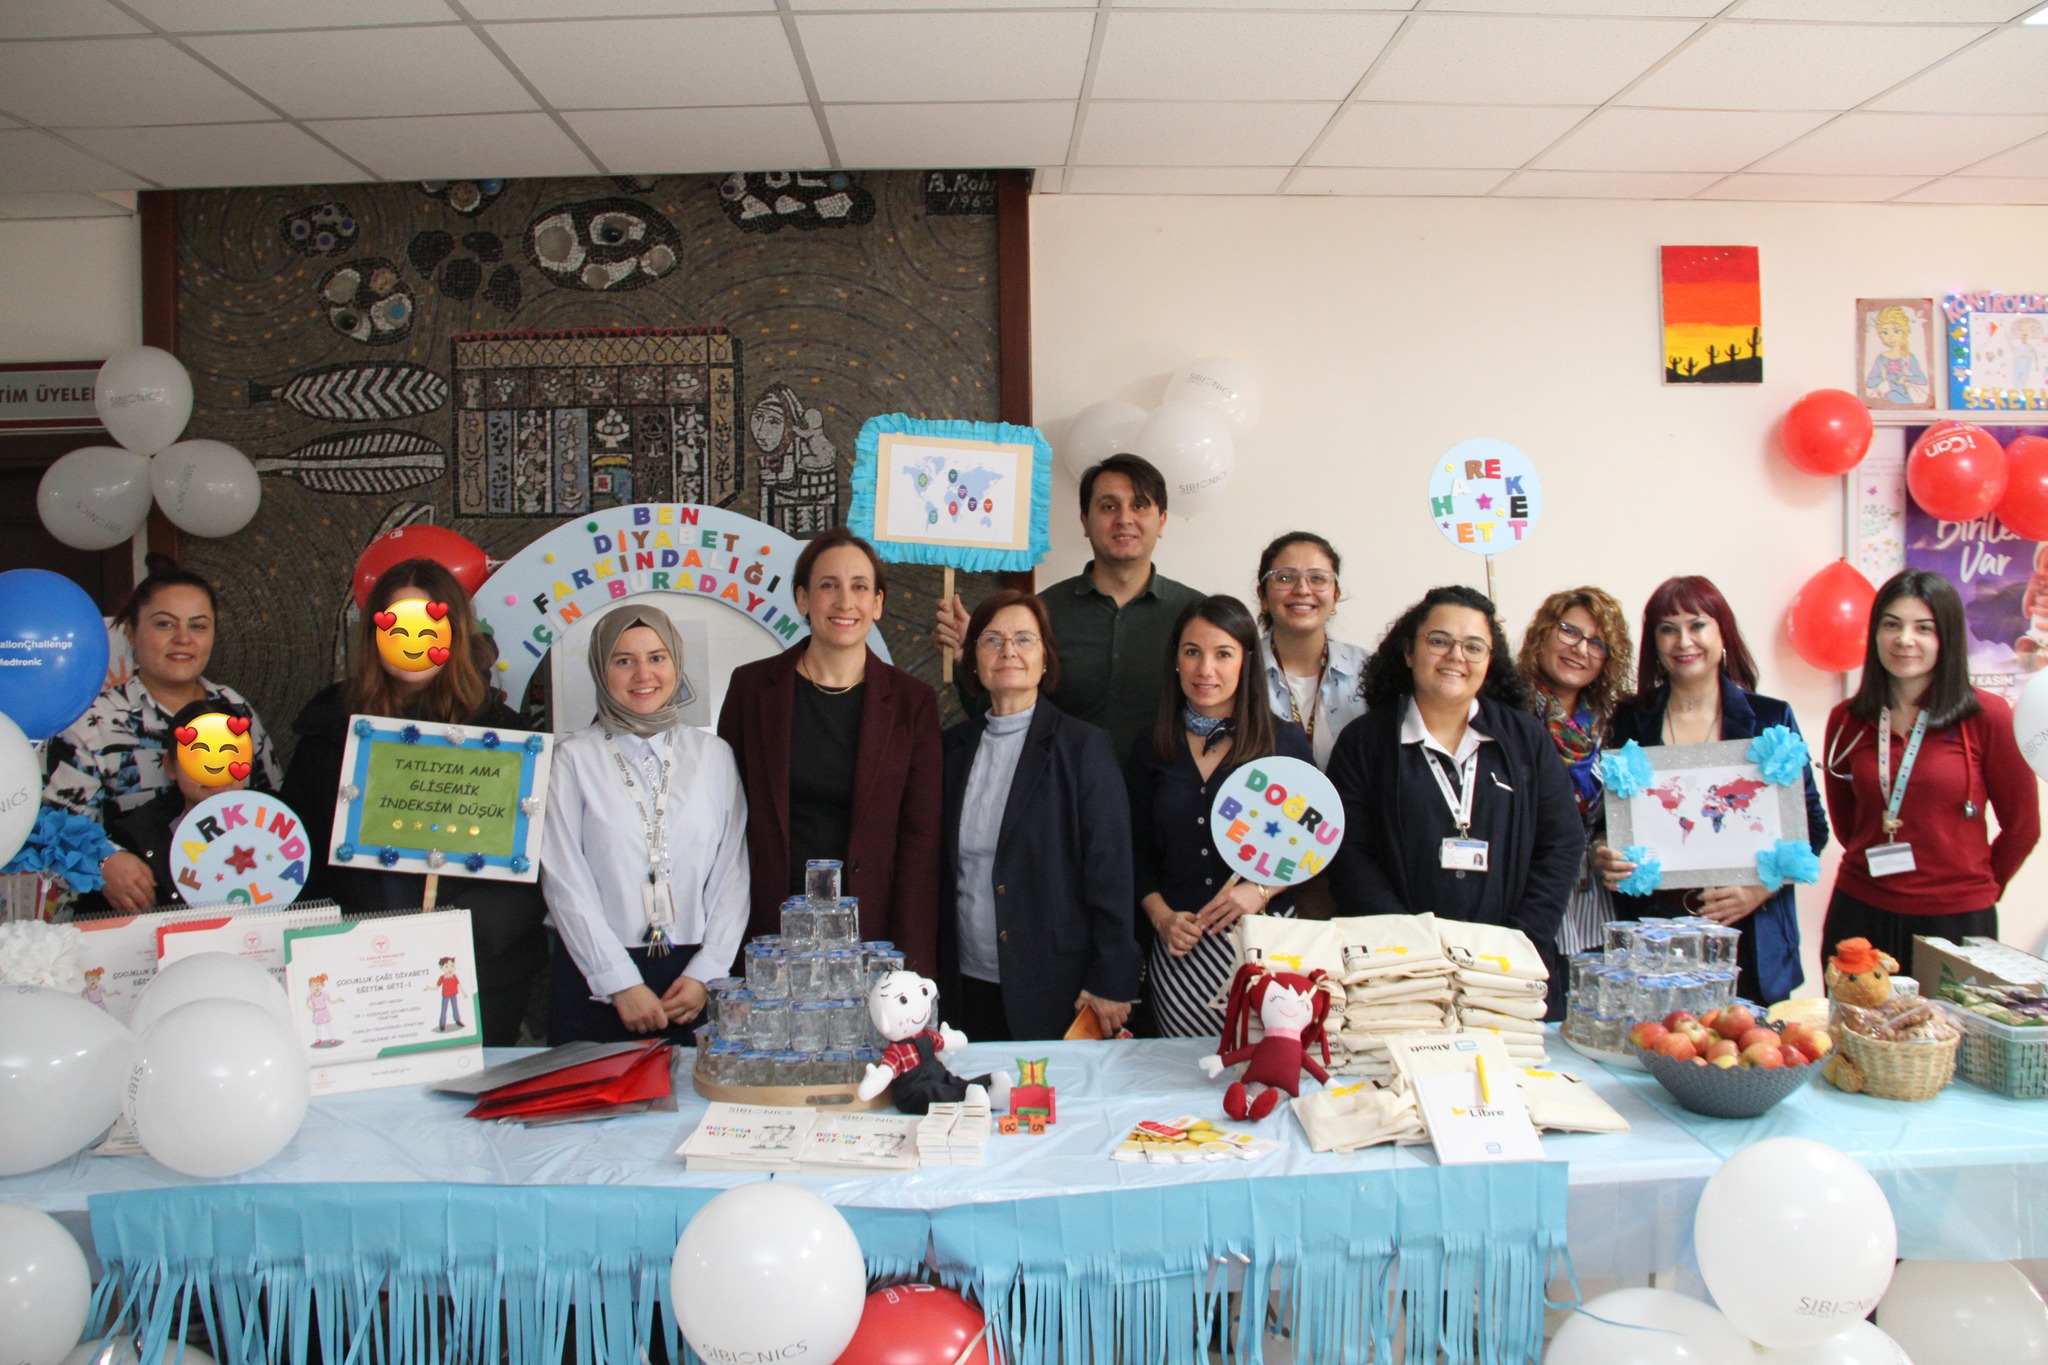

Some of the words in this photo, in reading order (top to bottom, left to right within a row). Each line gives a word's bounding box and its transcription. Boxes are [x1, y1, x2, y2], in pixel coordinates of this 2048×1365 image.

[633, 506, 700, 526] BEN
[1960, 540, 2013, 584] Var
[532, 548, 781, 616] FARKINDALIĞI
[607, 571, 800, 642] BURADAYIM
[395, 758, 464, 775] TATLIYIM
[469, 766, 501, 778] AMA
[409, 779, 480, 796] GLİSEMİK
[379, 795, 453, 814] İNDEKSİM
[458, 802, 506, 819] DÜŞÜK
[1244, 768, 1341, 845] DOĞRU
[1218, 795, 1326, 882] BESLEN
[127, 1064, 144, 1129] SIBION
[1469, 1107, 1505, 1118] Libre
[1797, 1296, 1868, 1316] SIBION
[702, 1339, 808, 1364] SIBIONICS
